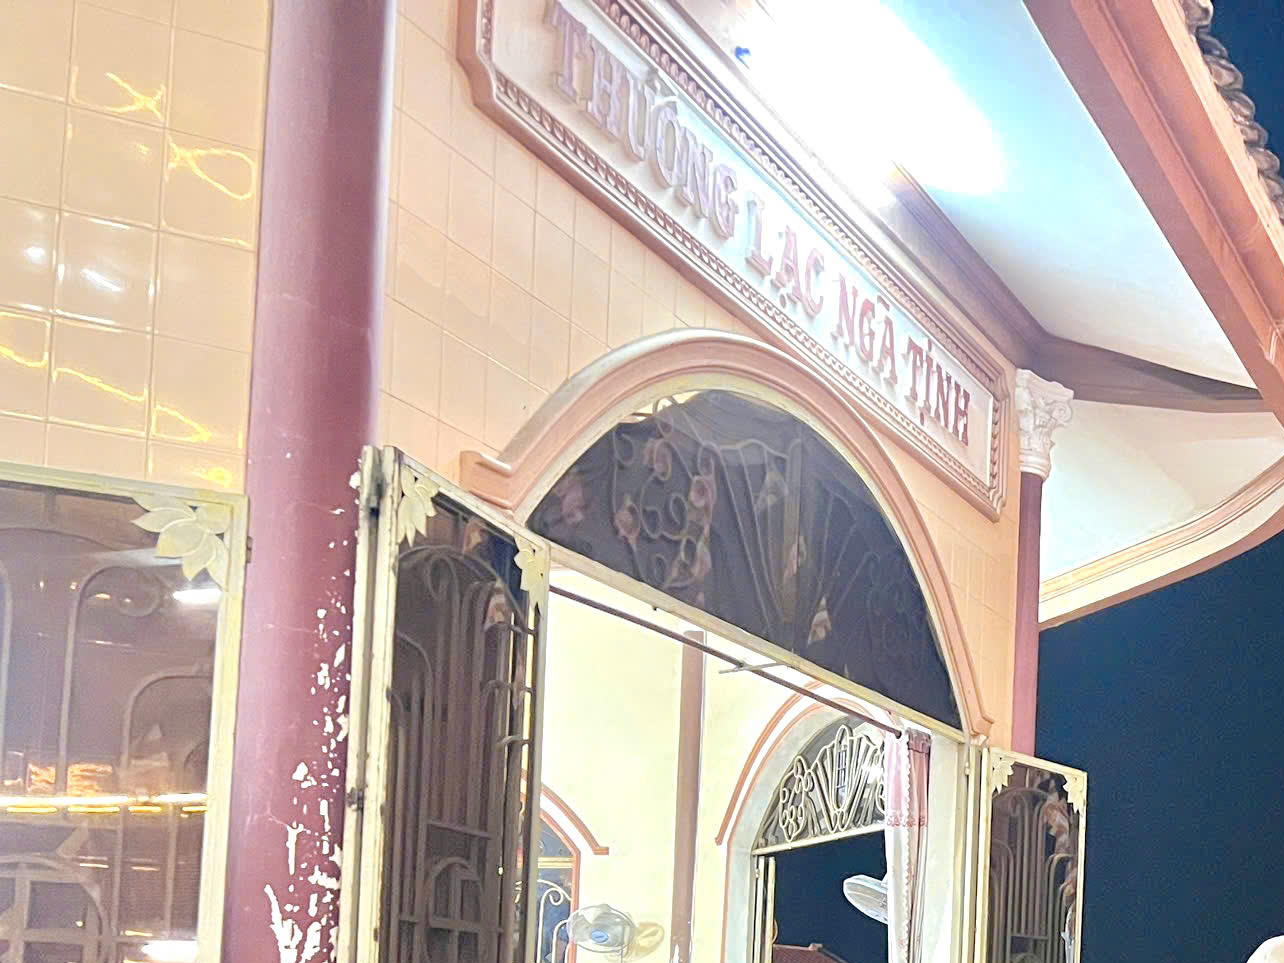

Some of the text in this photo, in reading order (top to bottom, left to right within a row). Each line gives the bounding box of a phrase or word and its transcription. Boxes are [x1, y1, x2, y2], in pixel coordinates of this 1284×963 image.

[745, 198, 825, 317] LẠC
[832, 271, 898, 386] NGÃ
[902, 334, 971, 446] TỊNH
